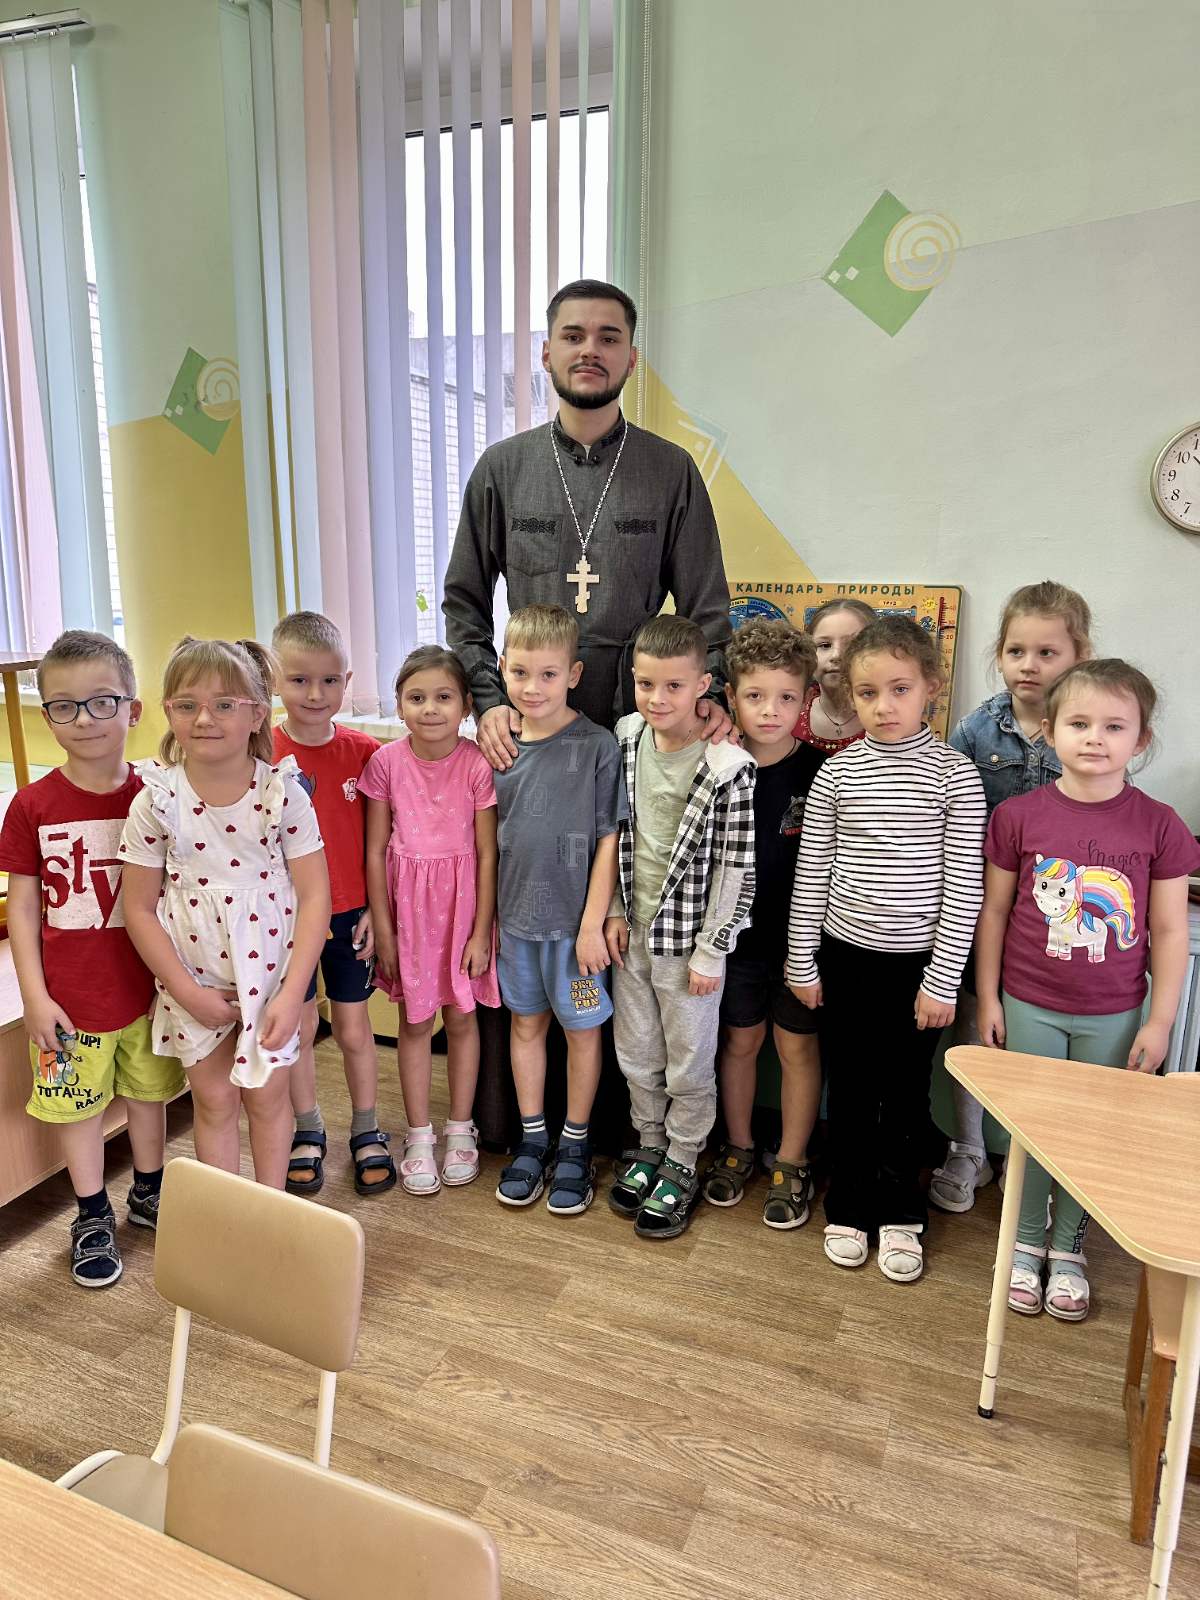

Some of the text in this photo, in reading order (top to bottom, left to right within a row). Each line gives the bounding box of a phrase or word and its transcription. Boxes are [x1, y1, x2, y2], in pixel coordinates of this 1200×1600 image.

[1176, 451, 1191, 464] 10
[1167, 469, 1177, 482] 9
[1171, 488, 1180, 501] 8
[1183, 501, 1192, 514] 7
[735, 583, 915, 597] КАЛЕНДАРЬ ПРИРОДЫ
[571, 979, 594, 990] SET
[575, 998, 599, 1009] FUN
[80, 1034, 101, 1048] UP!
[37, 1085, 92, 1098] TOTALLY
